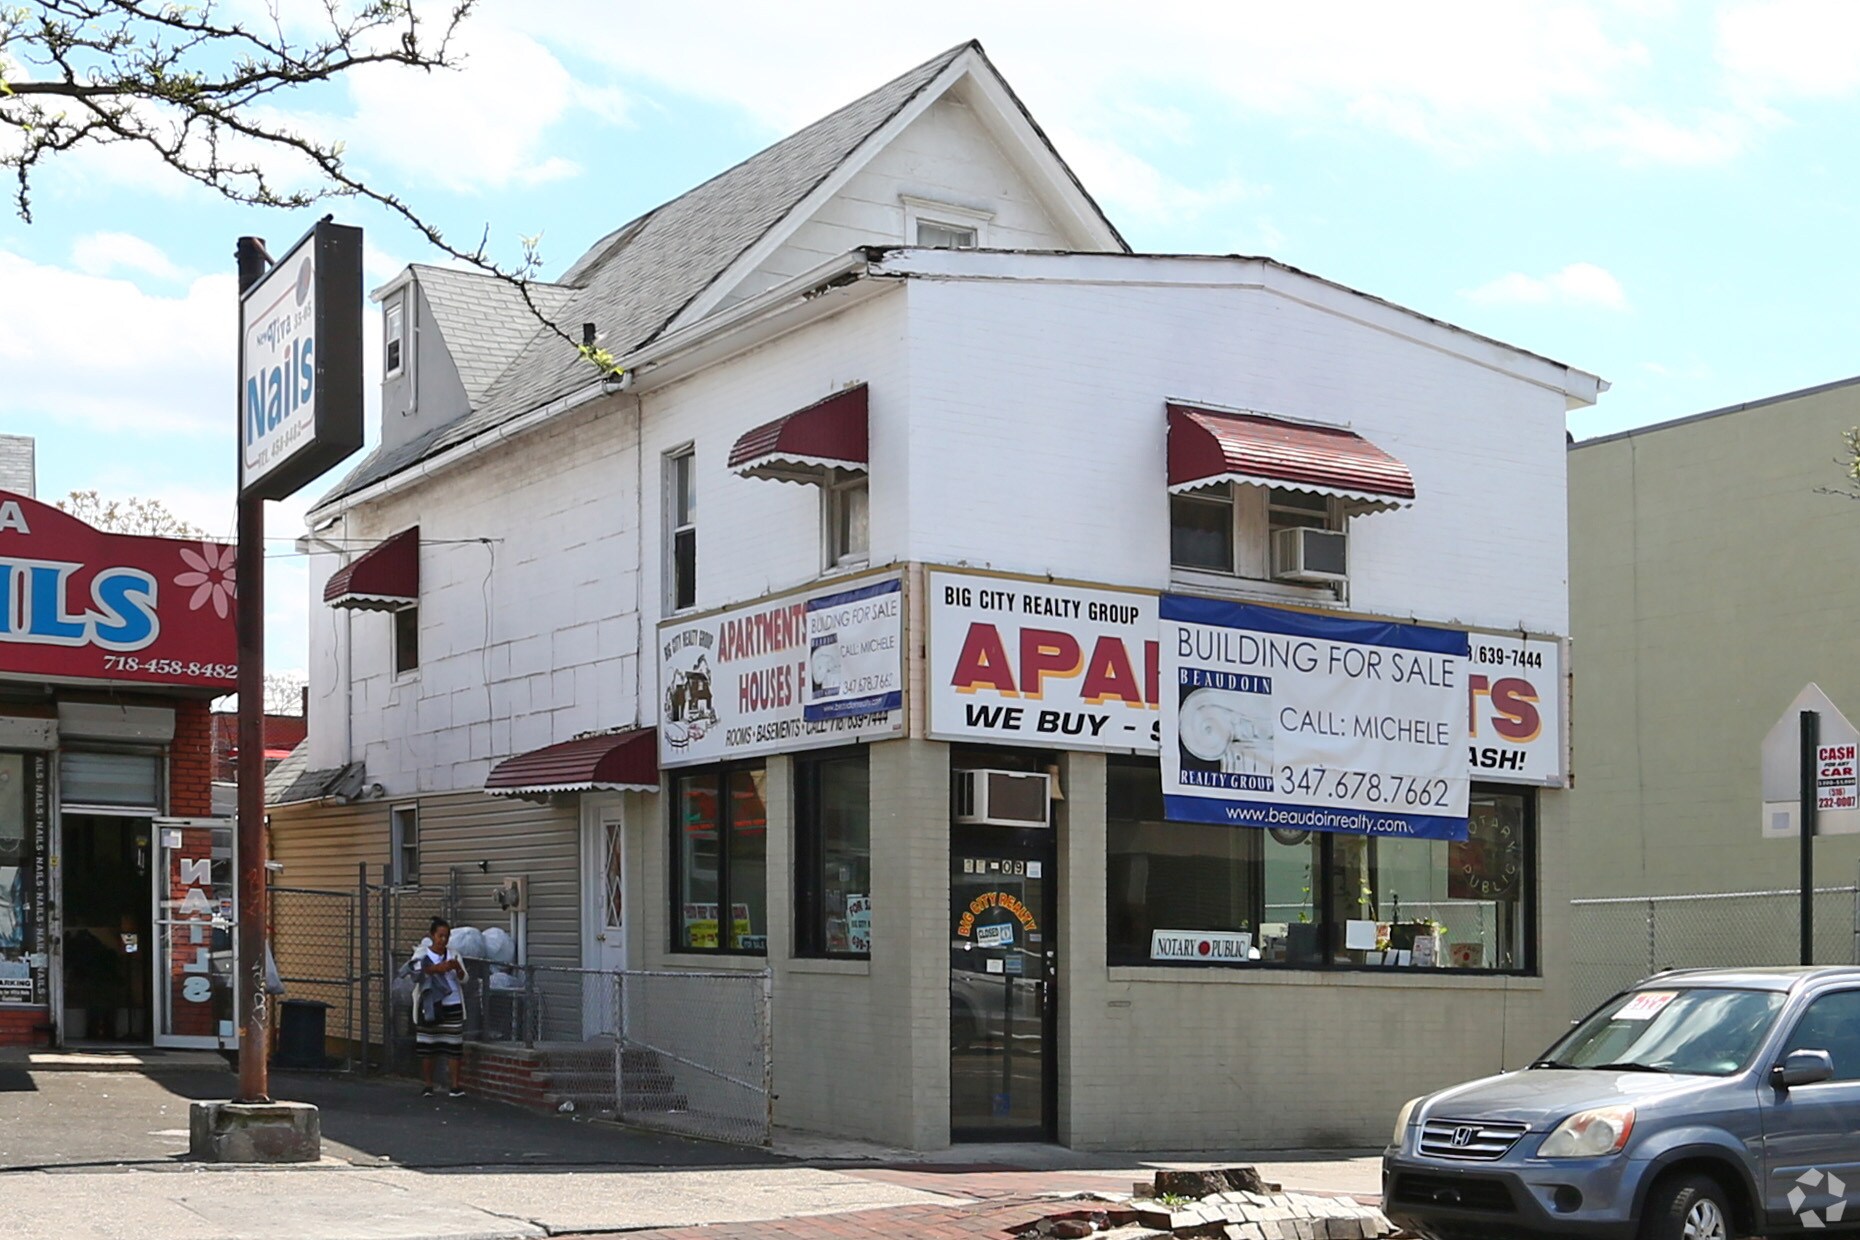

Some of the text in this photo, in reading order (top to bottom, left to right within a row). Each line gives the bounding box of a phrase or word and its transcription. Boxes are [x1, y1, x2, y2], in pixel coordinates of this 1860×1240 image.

[247, 336, 314, 448] Nails
[811, 600, 897, 634] BUILDING FOR SALE
[944, 586, 971, 607] BIG
[979, 590, 1016, 612] CITY
[1023, 595, 1081, 619] REALTY
[1088, 602, 1140, 625] GROUP
[861, 636, 895, 656] MICHELE
[1178, 627, 1455, 688] BUILDING FOR SALE
[103, 655, 239, 679] 718-458-8482
[950, 621, 1160, 710] APA
[739, 665, 792, 714] HOUSES
[1180, 668, 1271, 694] BEAUDOIN
[726, 727, 752, 747] ROOMS
[756, 718, 801, 743] BASEMENTS
[965, 704, 1024, 731] WE
[1036, 710, 1110, 737] BUY
[1279, 707, 1449, 746] CALL: MICHELE
[1180, 770, 1273, 792] REALTY GROUP
[1280, 765, 1450, 808] 347.678.7662
[1821, 767, 1854, 777] CAR
[36, 784, 45, 815] NAILS
[1225, 806, 1408, 834] www.beaudoinrealty.com
[36, 821, 45, 851] NAILS
[36, 857, 45, 887] NAILS
[1463, 863, 1517, 894] PUBLIC
[36, 893, 45, 922] NAILS
[958, 891, 1038, 937] BIG CITY REALTY
[36, 929, 45, 954] NAIL
[1156, 938, 1245, 958] NOTARY PUBLIC
